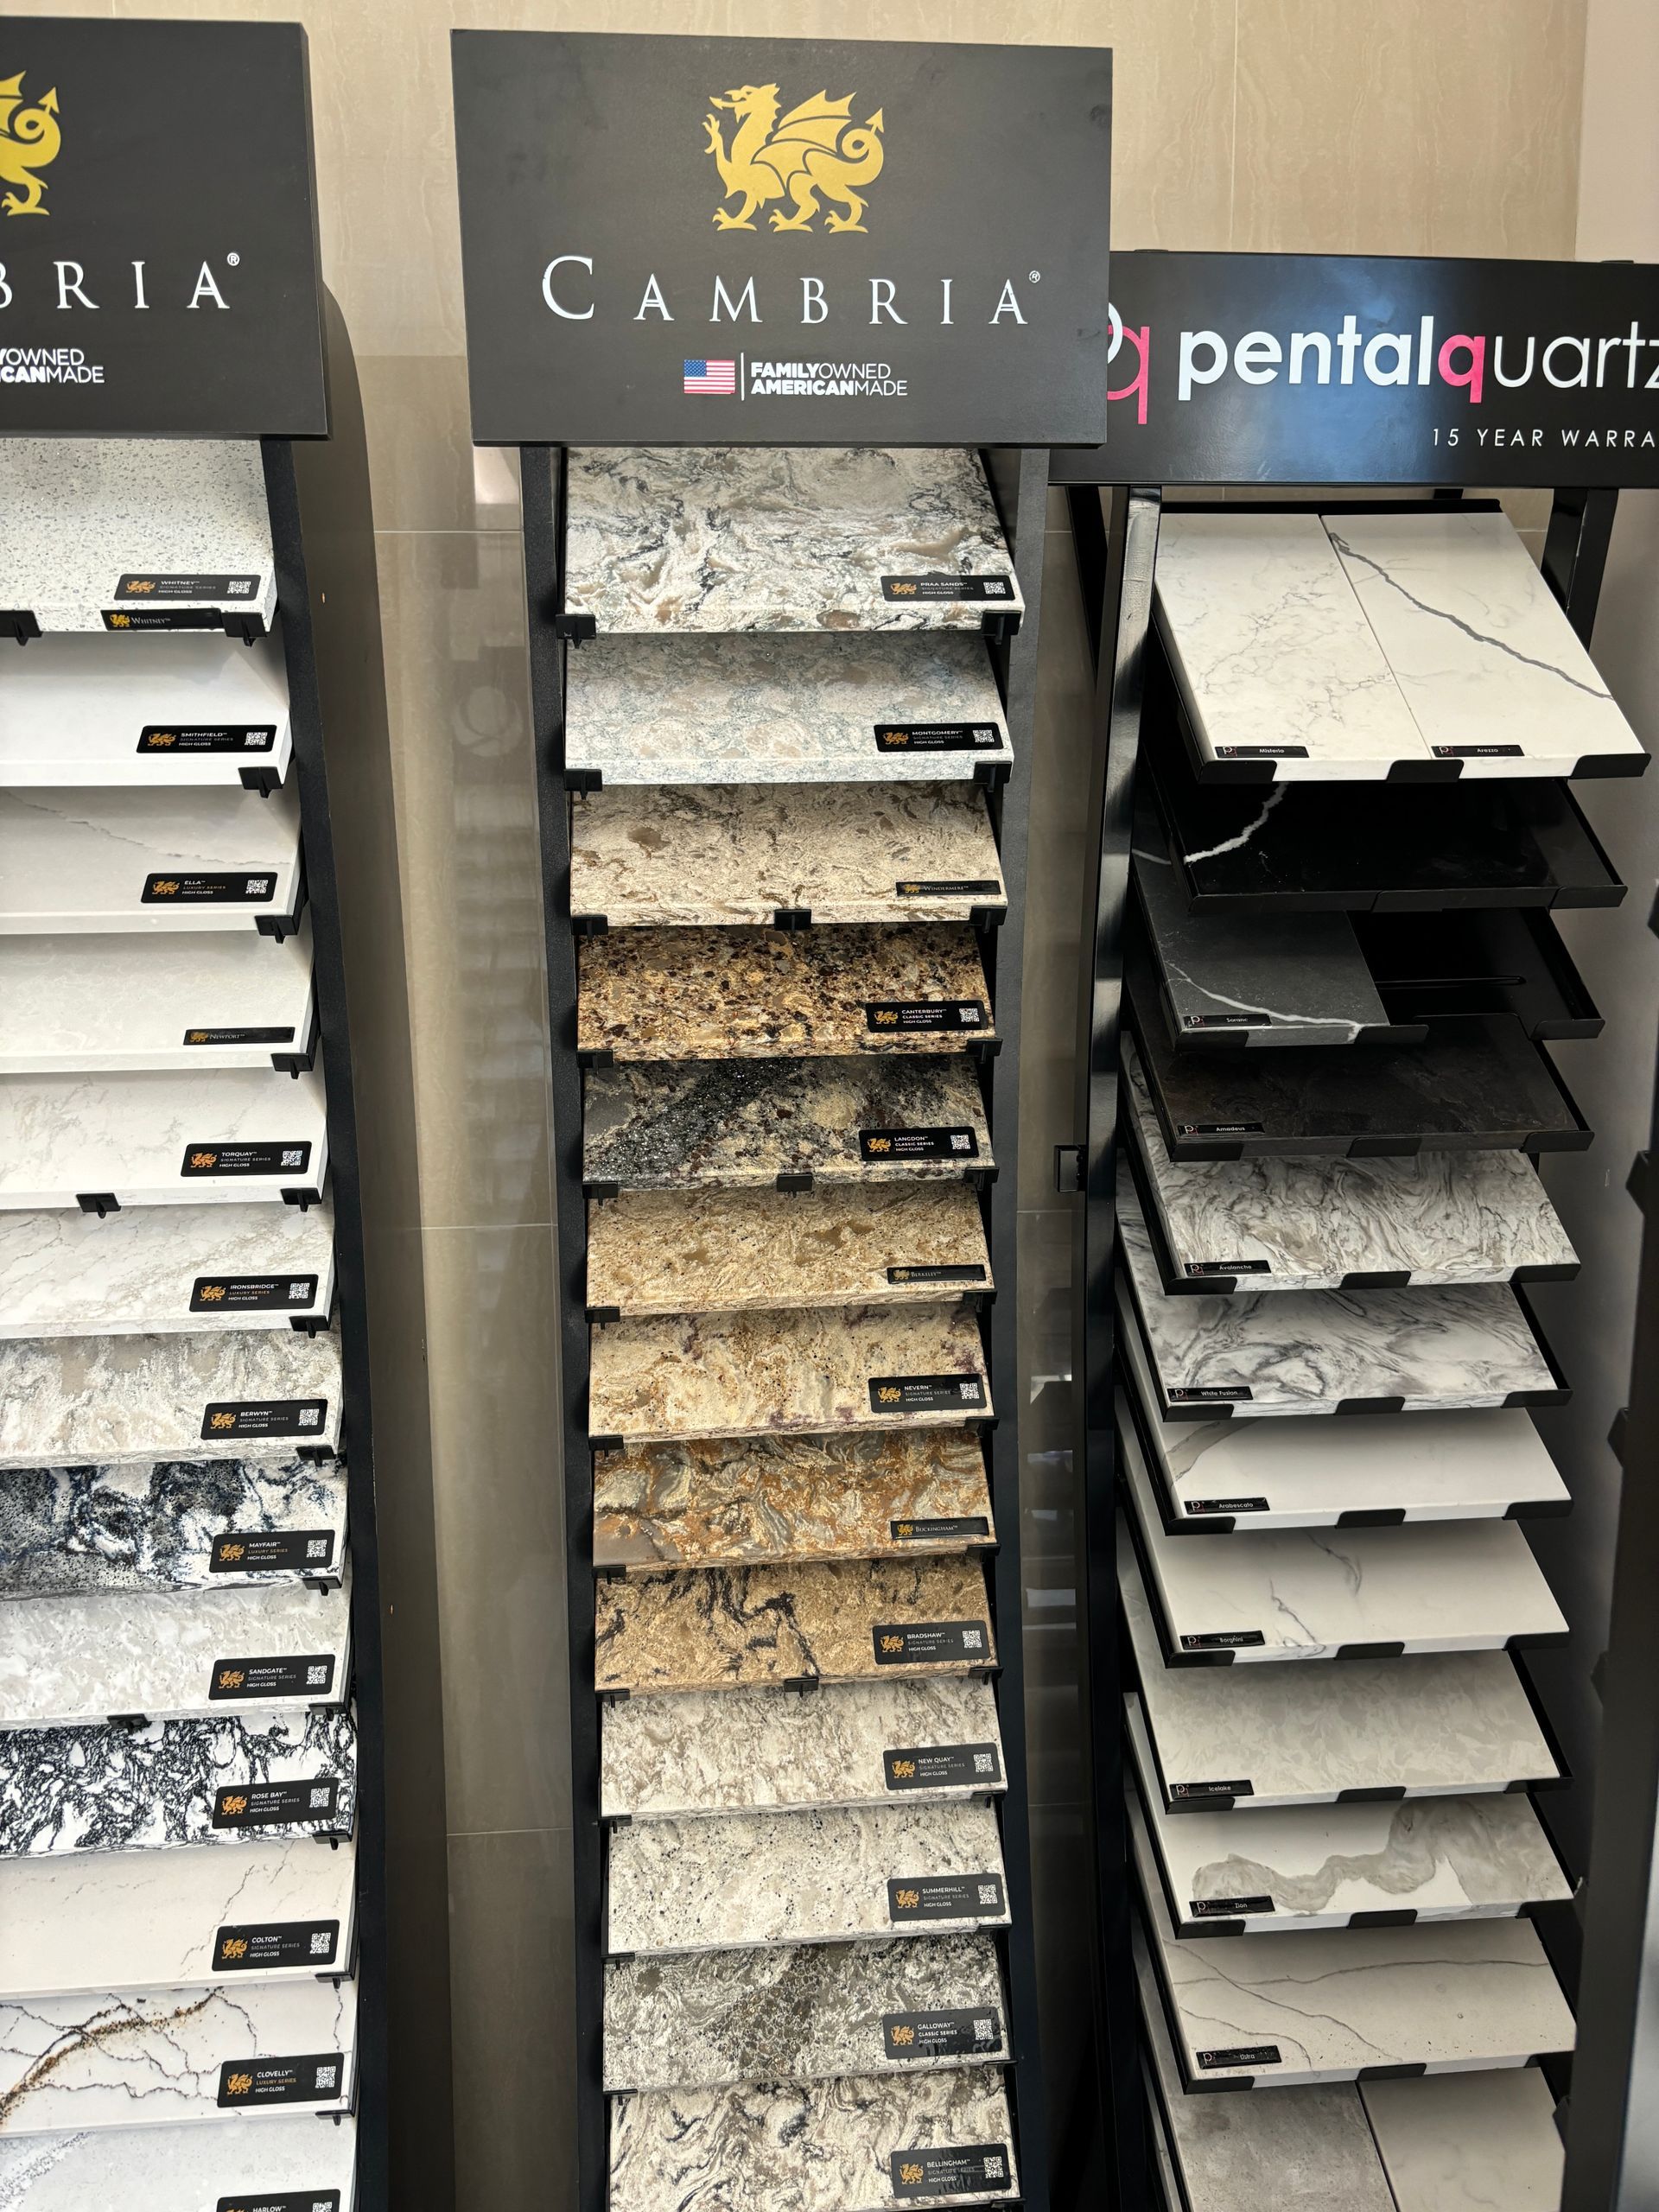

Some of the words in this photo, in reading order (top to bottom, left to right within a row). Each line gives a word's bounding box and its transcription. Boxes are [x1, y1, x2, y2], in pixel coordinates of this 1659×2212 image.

[0, 366, 105, 383] CANMADE
[1433, 429, 1459, 447] 15
[1477, 429, 1543, 447] YEAR
[1561, 429, 1656, 448] WARRA
